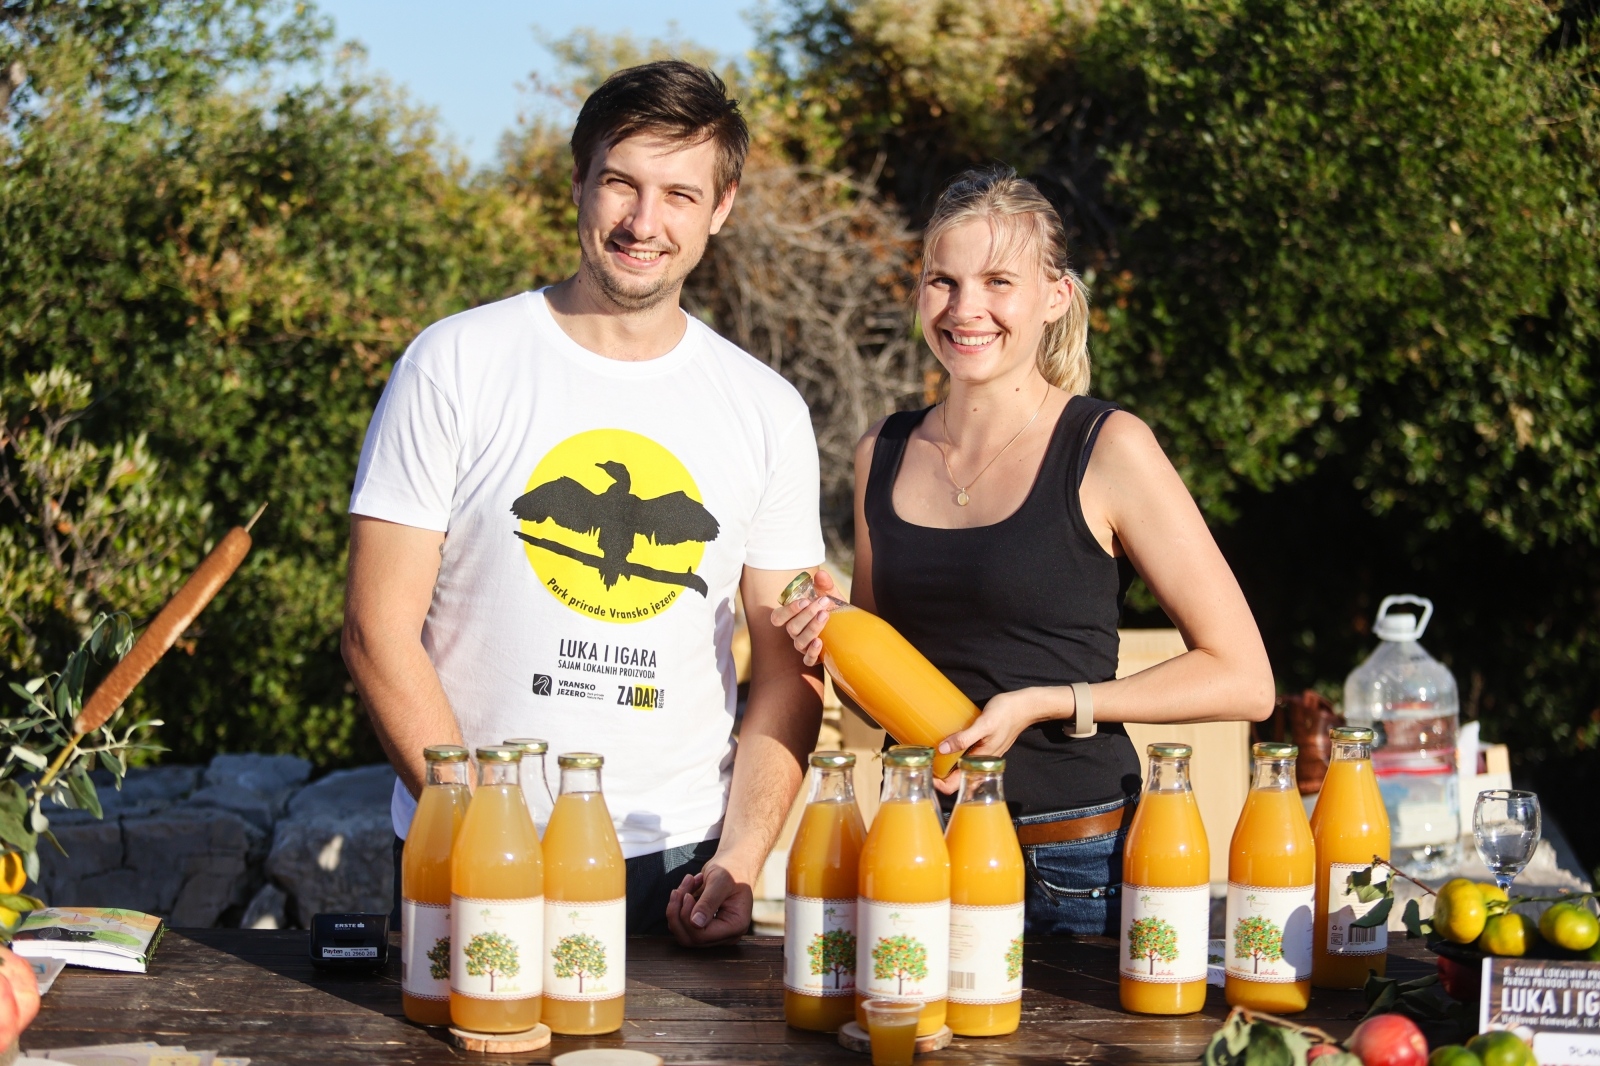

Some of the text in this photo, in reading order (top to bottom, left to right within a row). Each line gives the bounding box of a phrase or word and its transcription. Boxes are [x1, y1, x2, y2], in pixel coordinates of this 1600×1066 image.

[547, 577, 676, 619] Park prirode Vransko jezero
[559, 638, 657, 668] LUKA I IGARA
[557, 659, 655, 679] SAJAM LOKALNIH PROIZVODA
[556, 688, 586, 698] JEZERO
[558, 679, 596, 691] VRANSKO
[1515, 966, 1543, 978] SAJAM
[1543, 967, 1587, 979] LOKALNIH
[1502, 976, 1531, 987] PARKA
[1532, 977, 1568, 989] PRIRODE
[1501, 987, 1600, 1017] LUKA I IG
